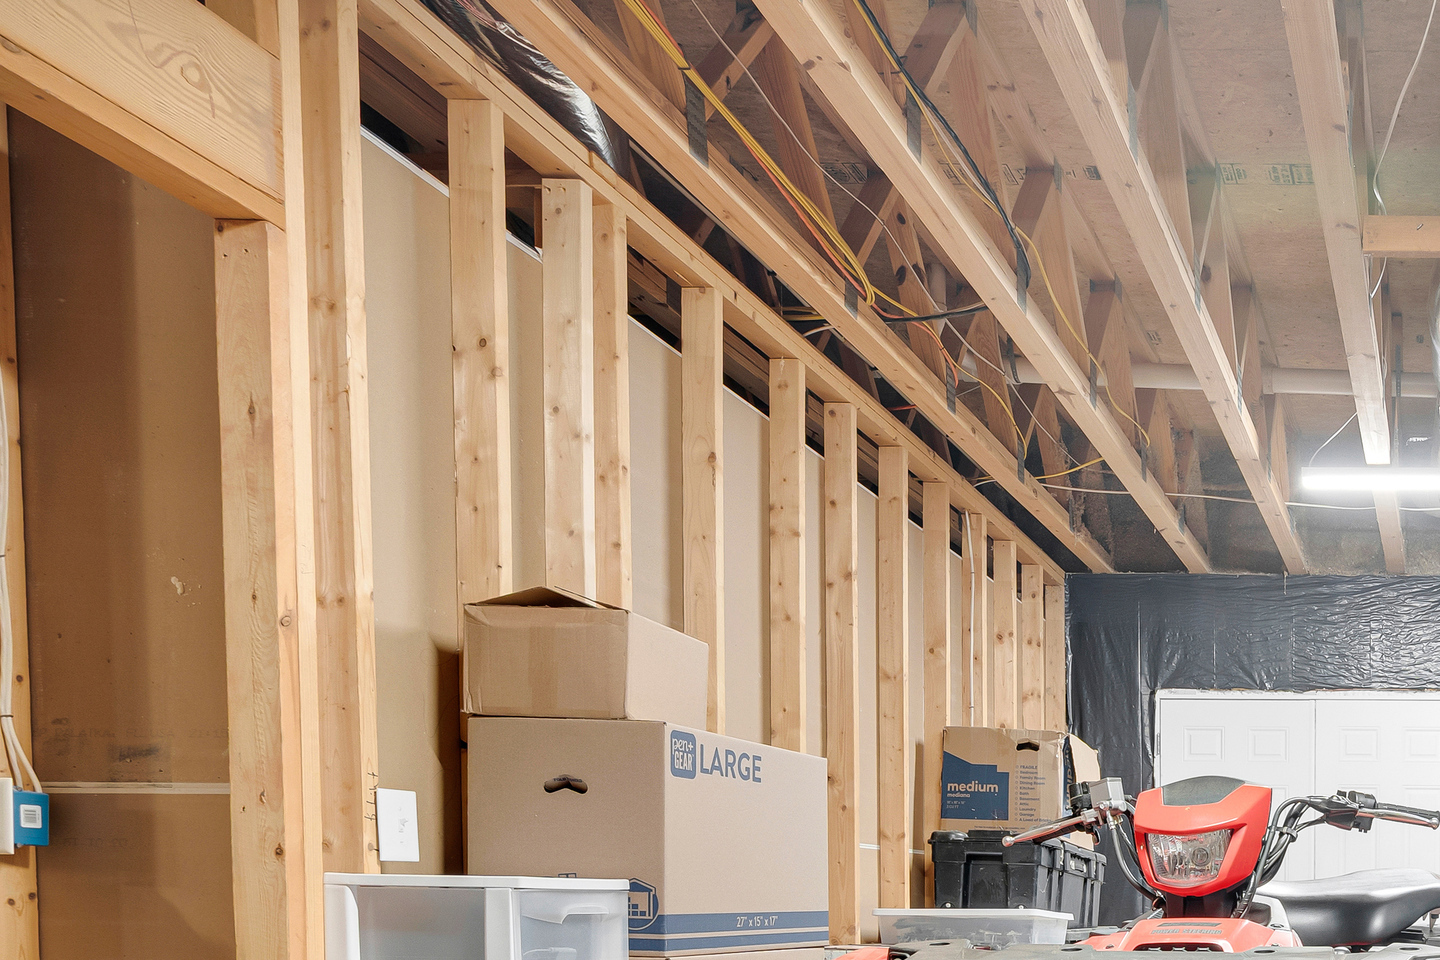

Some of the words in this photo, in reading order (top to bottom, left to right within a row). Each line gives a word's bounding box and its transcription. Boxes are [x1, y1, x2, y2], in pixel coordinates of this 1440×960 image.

[674, 751, 693, 771] GEAR
[700, 743, 762, 783] LARGE
[947, 780, 998, 792] medium
